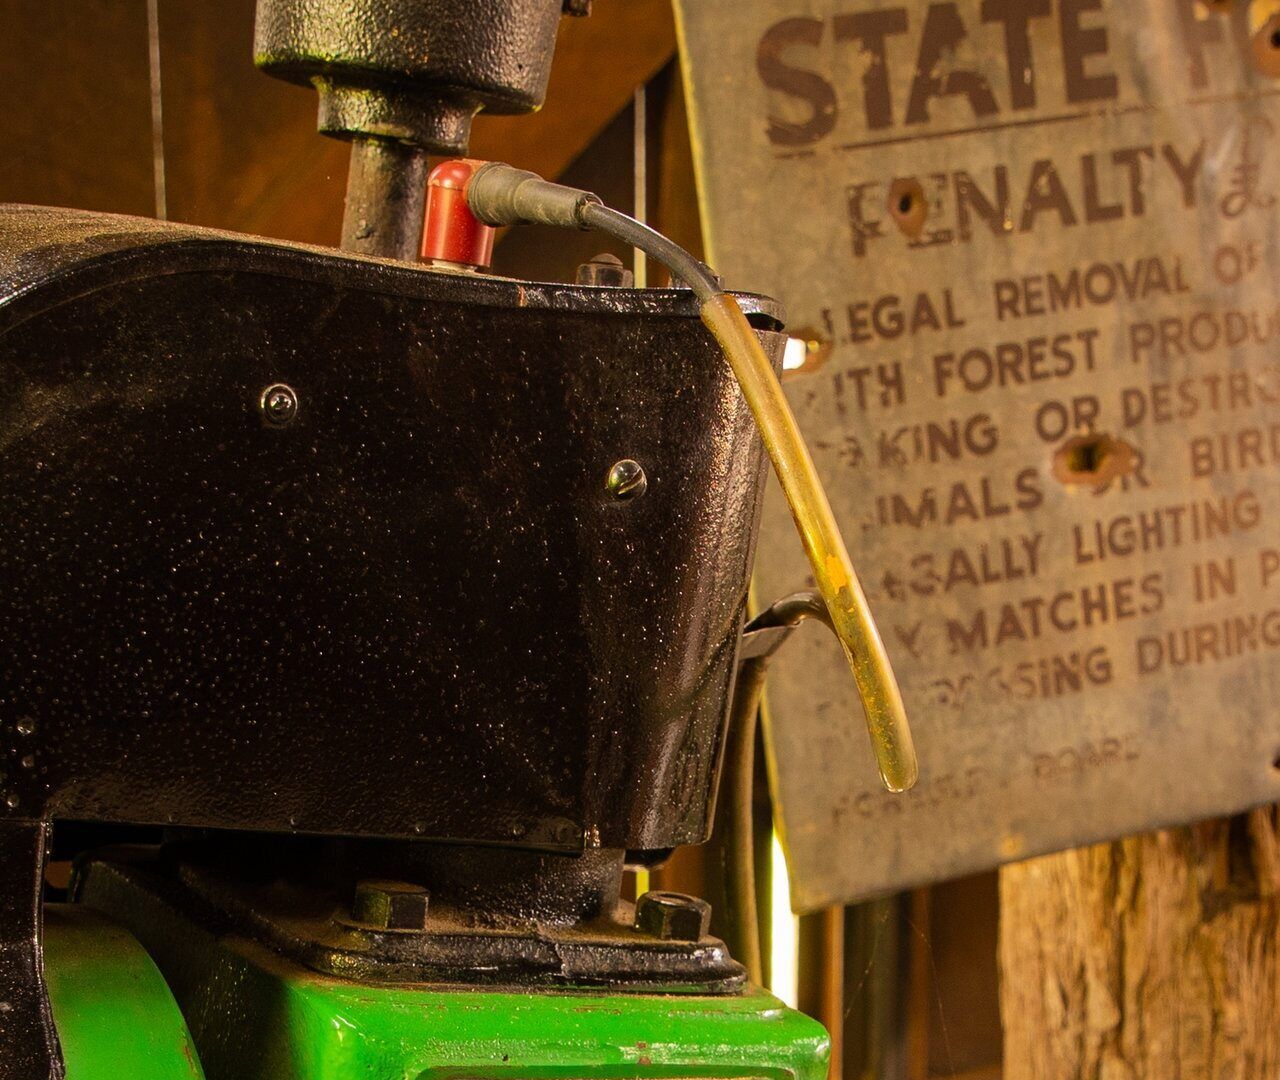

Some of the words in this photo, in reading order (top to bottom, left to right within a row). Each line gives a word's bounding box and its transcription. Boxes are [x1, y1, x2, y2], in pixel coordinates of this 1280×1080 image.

[755, 0, 1119, 146] STATE
[993, 255, 1190, 321] REMOVAL
[1214, 238, 1261, 285] OF
[831, 361, 906, 416] ITH
[933, 329, 1100, 398] FOREST
[1035, 396, 1100, 443] OR
[1073, 490, 1261, 563] LIGHTING
[946, 573, 1165, 655] MATCHES
[1191, 557, 1237, 604] IN
